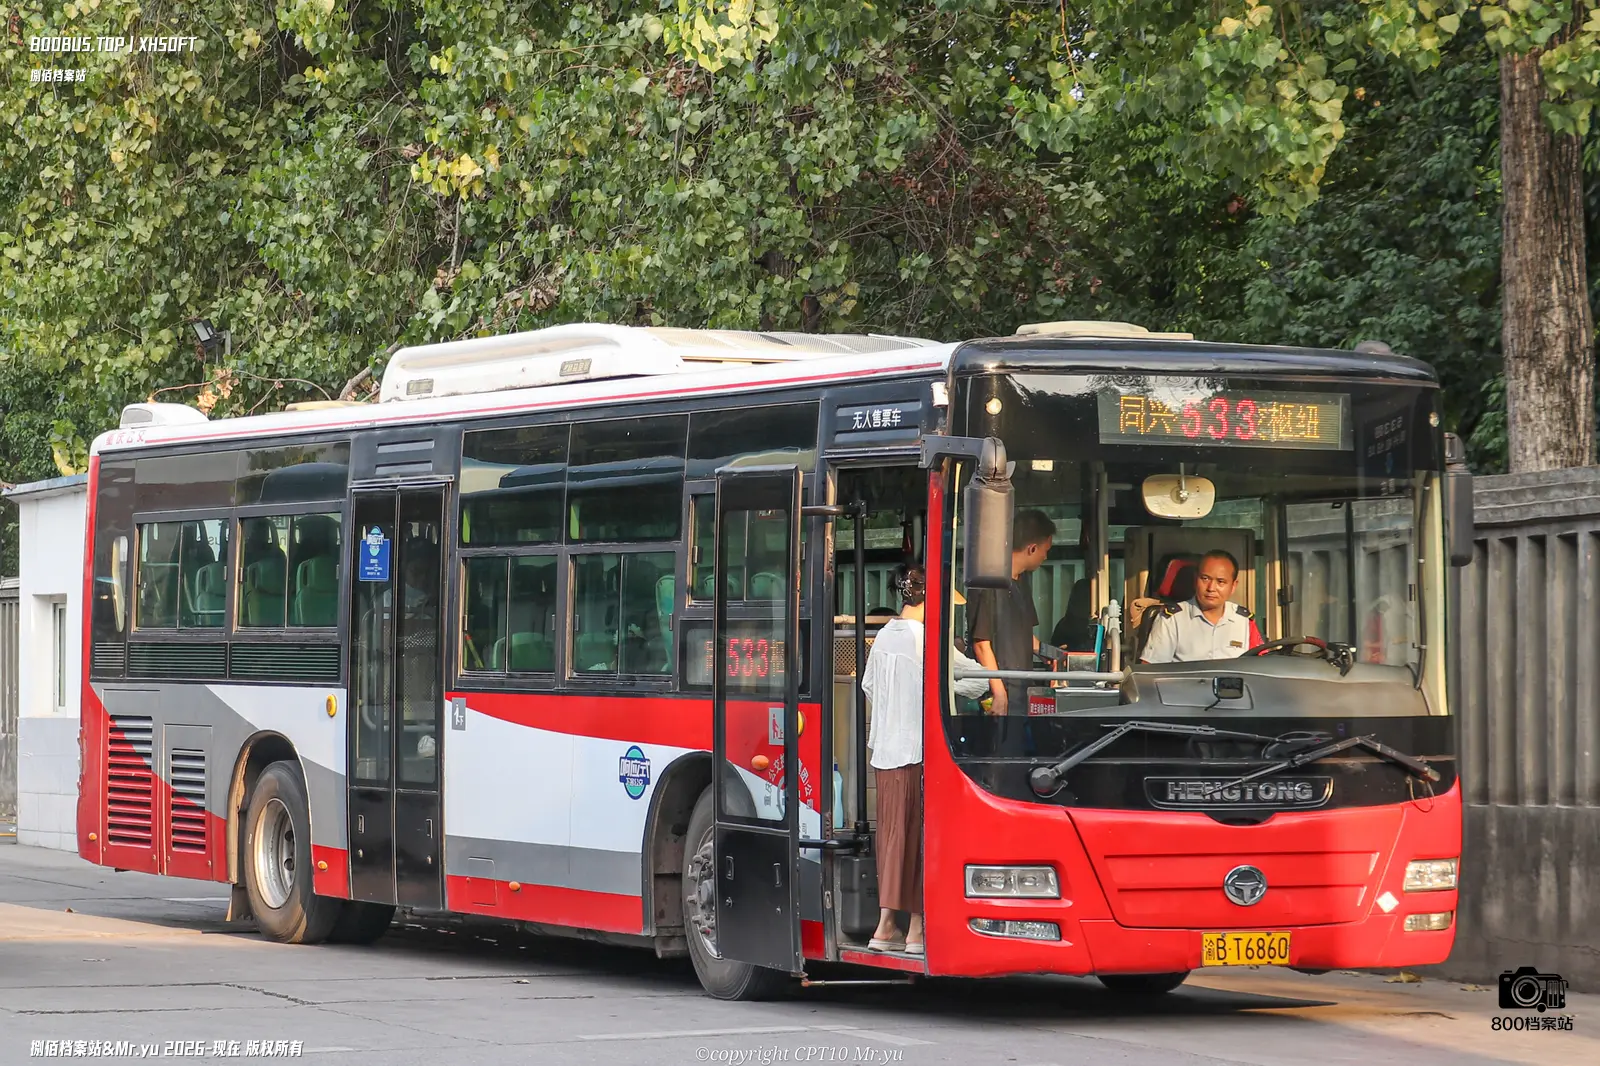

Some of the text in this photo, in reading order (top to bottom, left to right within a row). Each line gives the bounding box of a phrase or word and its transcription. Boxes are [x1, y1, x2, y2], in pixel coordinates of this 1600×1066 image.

[852, 407, 902, 429] 无人售票车
[1180, 396, 1258, 440] 533
[727, 638, 769, 677] 533
[1167, 781, 1313, 801] HENGTONG
